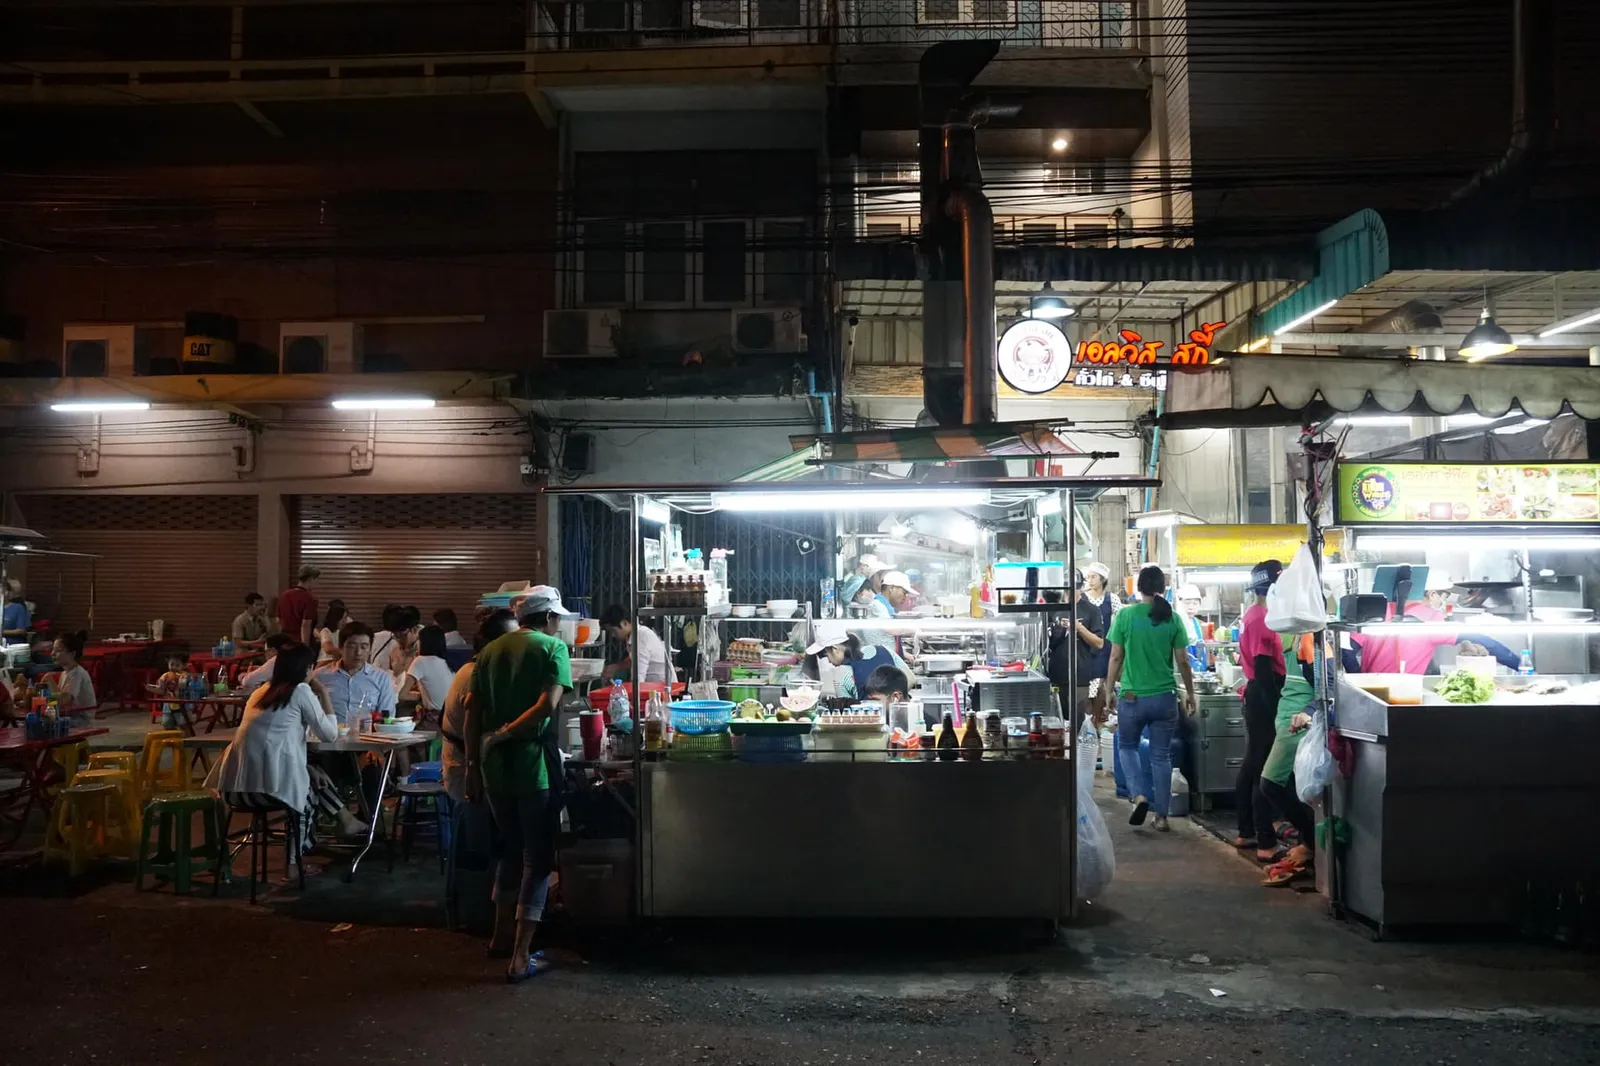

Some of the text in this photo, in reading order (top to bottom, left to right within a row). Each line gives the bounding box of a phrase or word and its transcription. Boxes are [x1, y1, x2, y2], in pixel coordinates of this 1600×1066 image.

[191, 342, 215, 357] CAT
[1077, 329, 1165, 365] เอลวิส
[1075, 368, 1114, 386] คั่วไก่
[1120, 373, 1134, 386] &
